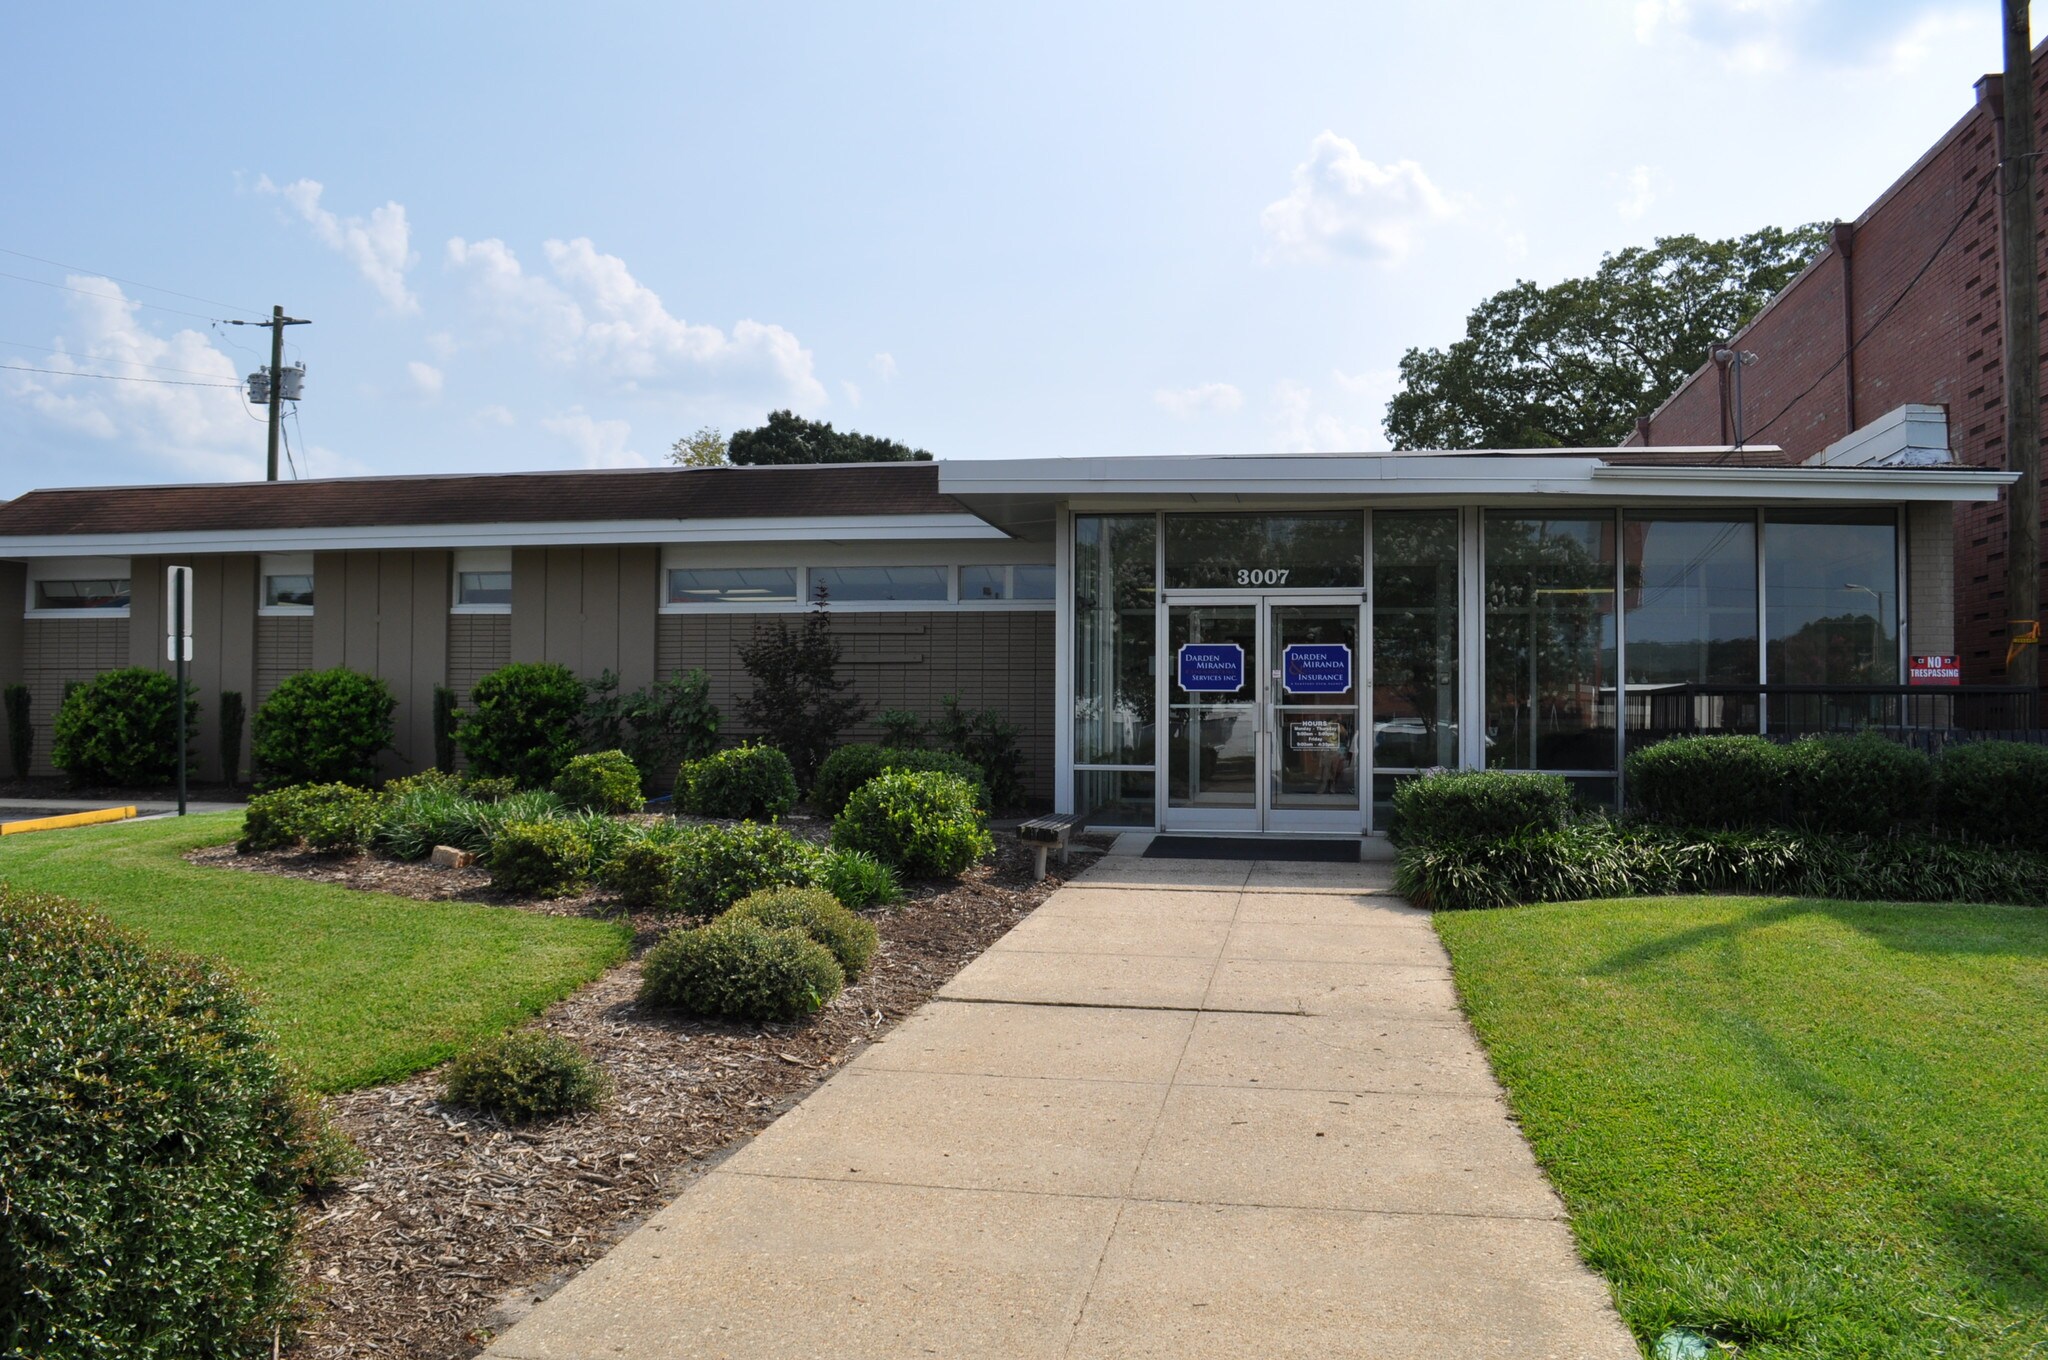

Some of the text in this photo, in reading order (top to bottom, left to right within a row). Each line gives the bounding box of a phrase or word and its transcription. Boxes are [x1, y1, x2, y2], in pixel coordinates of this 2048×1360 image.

[1237, 568, 1290, 585] 3007
[1185, 654, 1220, 662] DARDEN
[1291, 653, 1327, 661] DARDEN
[1927, 656, 1942, 668] NO
[1910, 669, 1959, 677] TRESPASSING
